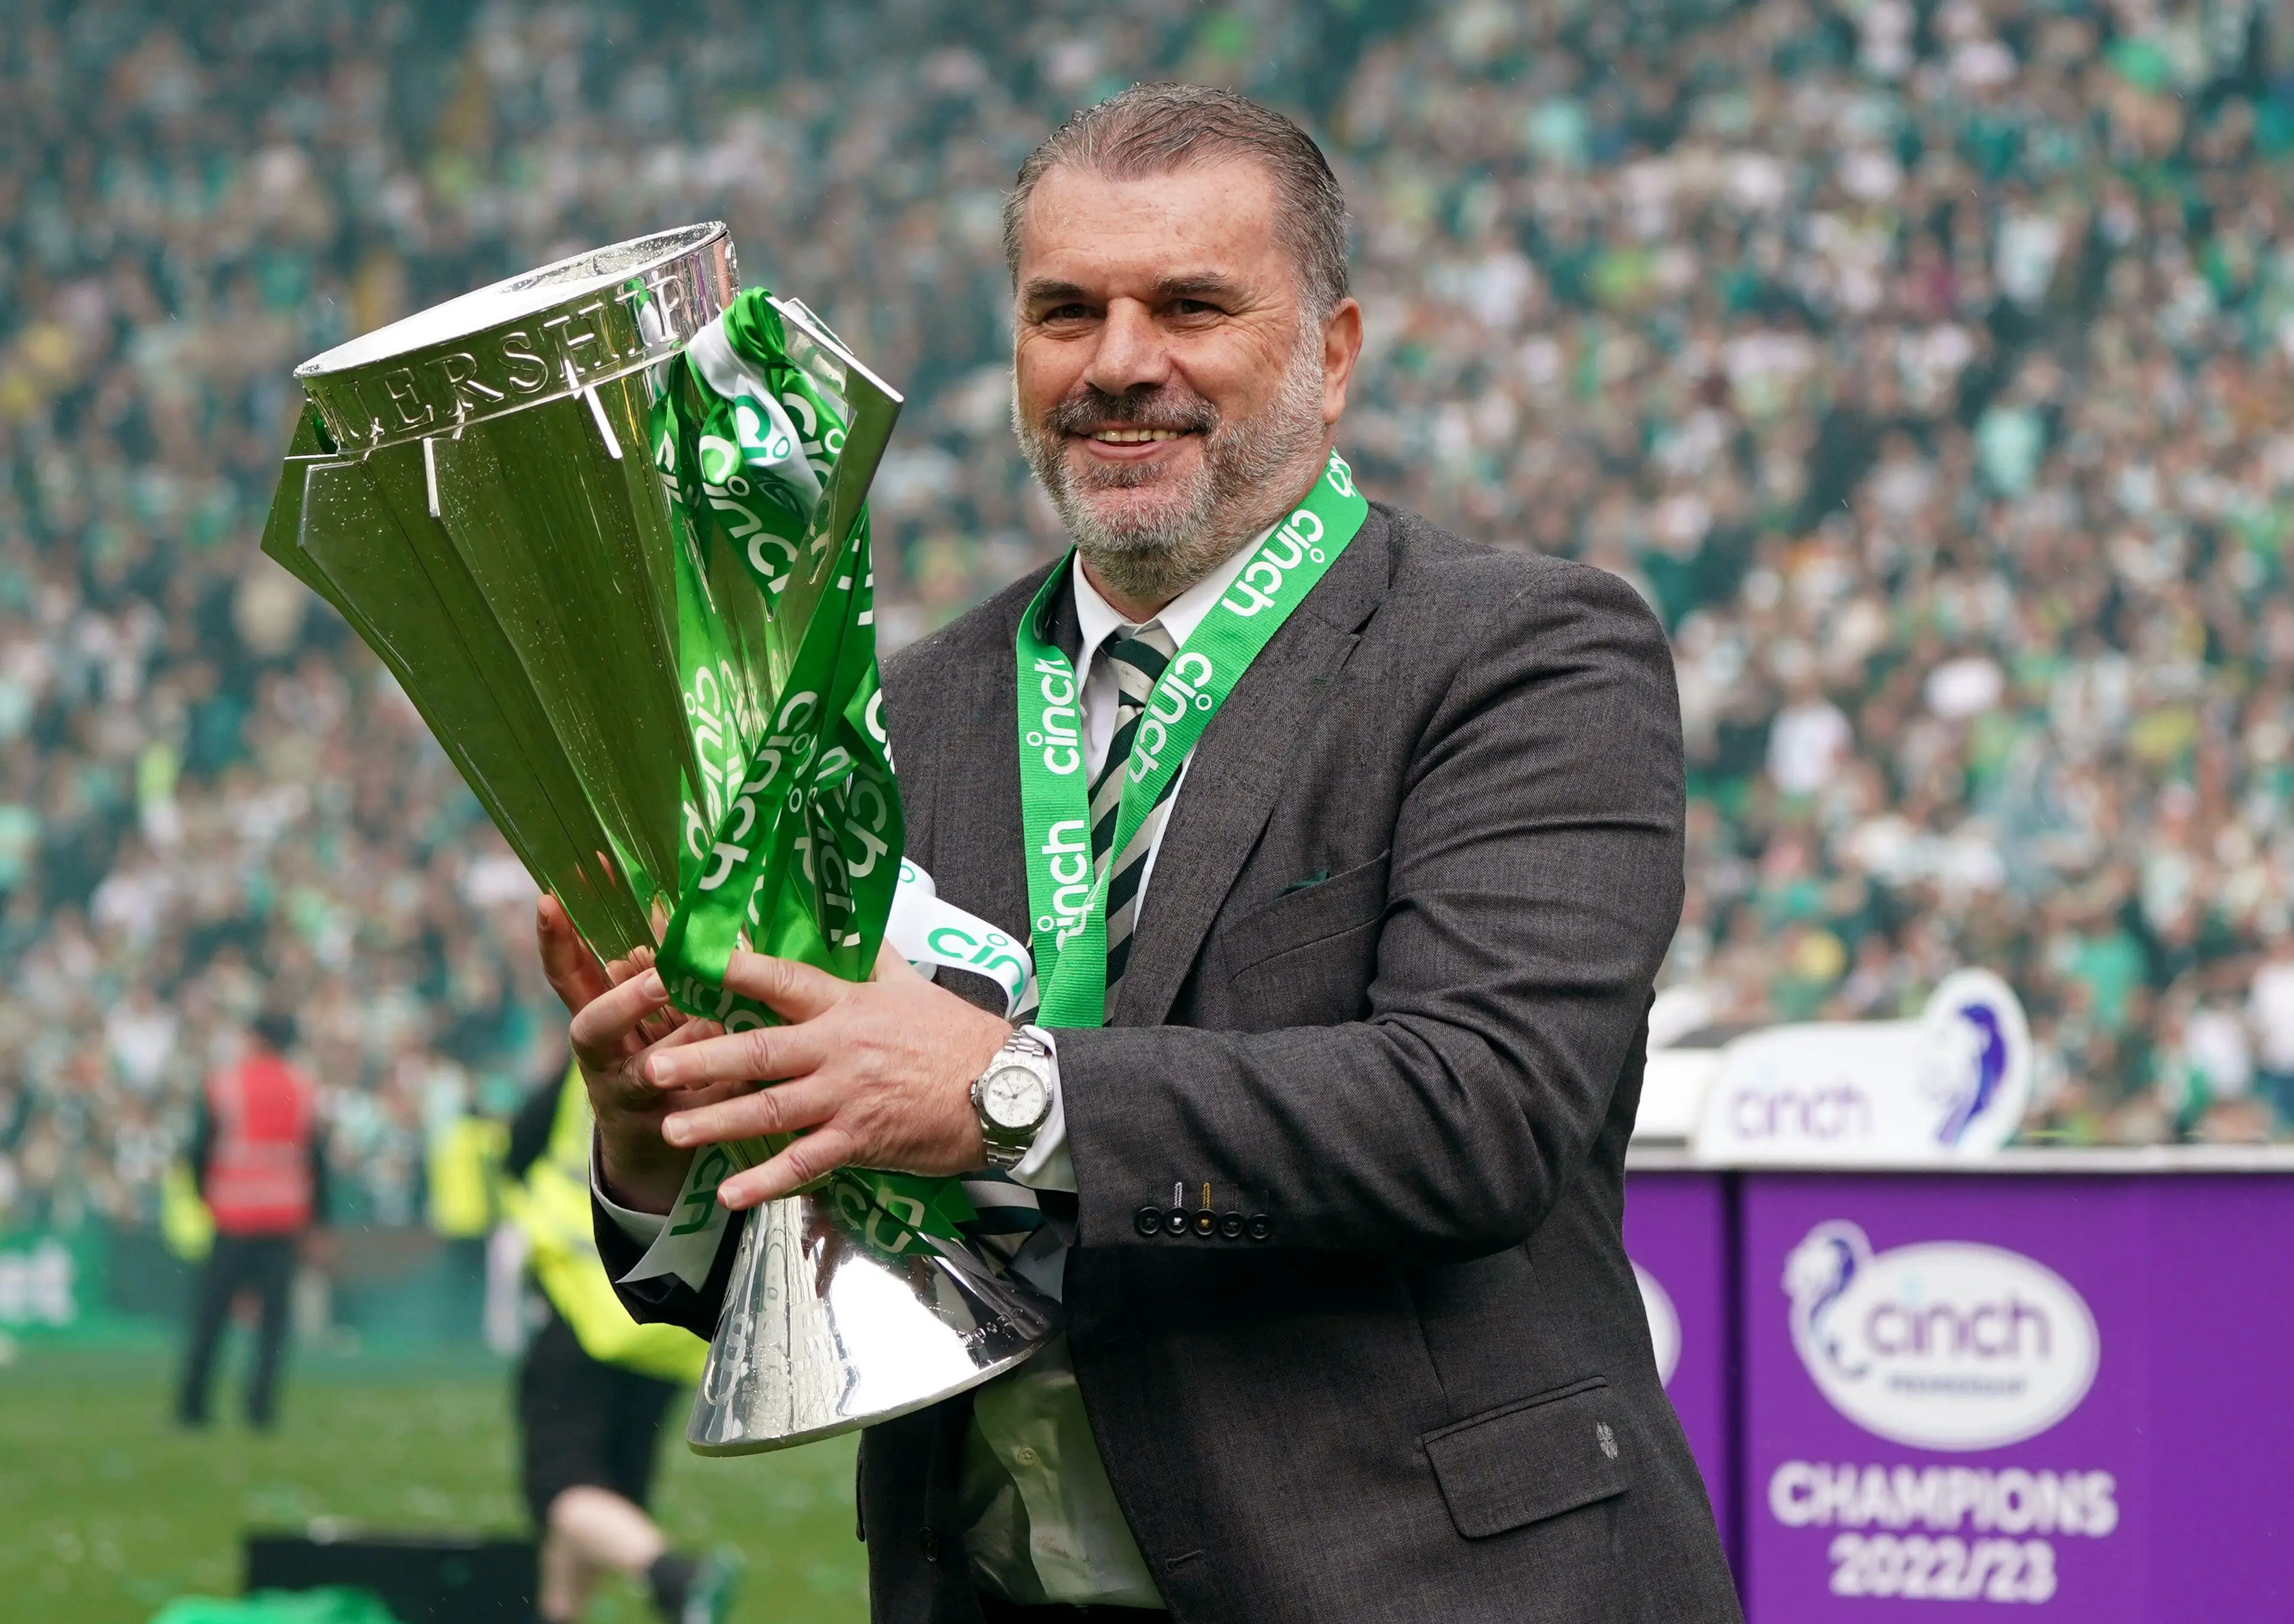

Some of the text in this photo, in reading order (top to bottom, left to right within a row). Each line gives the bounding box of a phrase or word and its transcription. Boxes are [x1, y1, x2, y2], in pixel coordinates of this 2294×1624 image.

[1221, 509, 1325, 617] cinch
[1129, 652, 1213, 784] cinch
[698, 691, 819, 890] cinch
[927, 927, 1024, 999] cin
[1725, 1066, 1875, 1141] cinch
[1860, 1272, 2055, 1360] cinch
[1768, 1459, 2119, 1539] CHAMPIONS
[1827, 1531, 2057, 1604] 2022/23
